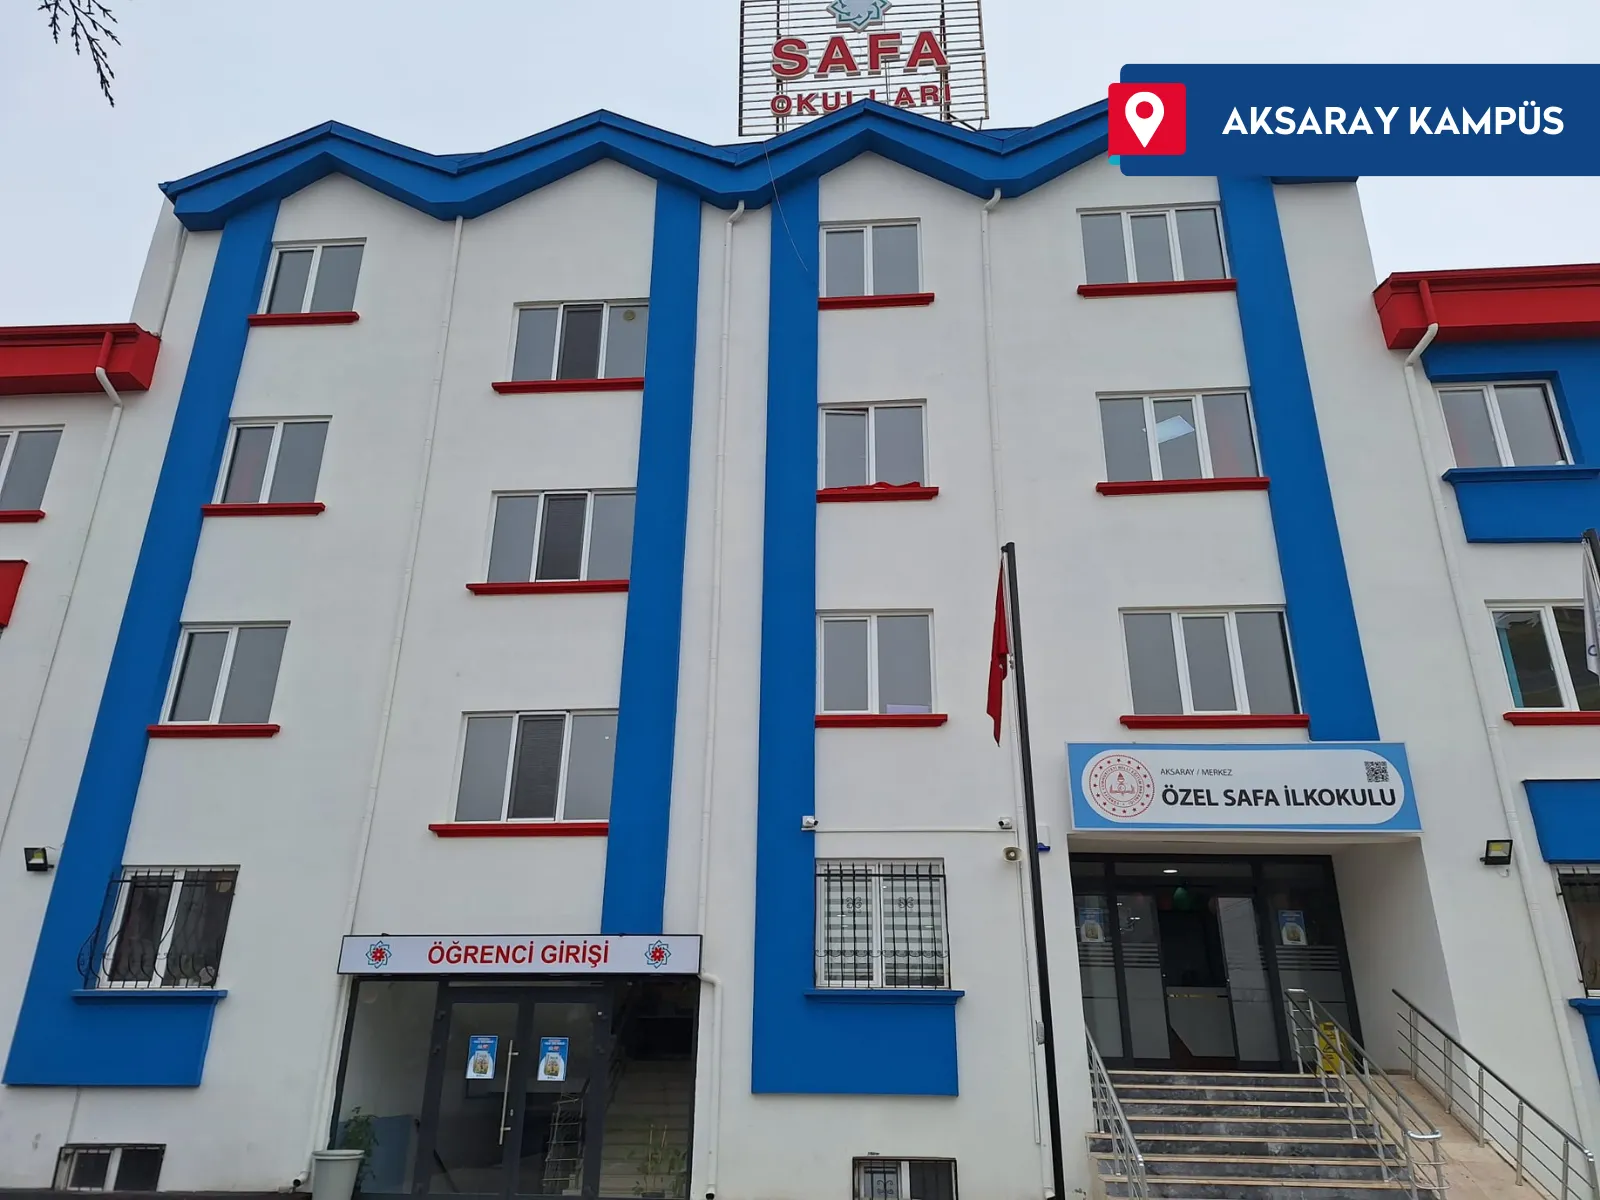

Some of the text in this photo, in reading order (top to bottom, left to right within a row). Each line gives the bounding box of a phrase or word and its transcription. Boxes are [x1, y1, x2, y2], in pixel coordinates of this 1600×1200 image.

[771, 30, 950, 79] SAFA
[1160, 768, 1195, 776] AKSARAY
[1201, 768, 1234, 777] MERKEZ
[1161, 784, 1219, 807] ÖZEL
[1223, 788, 1281, 807] SAFA
[1284, 784, 1397, 807] İLKOKULU
[428, 940, 610, 968] ÖĞRENCİ GİRİŞİ
